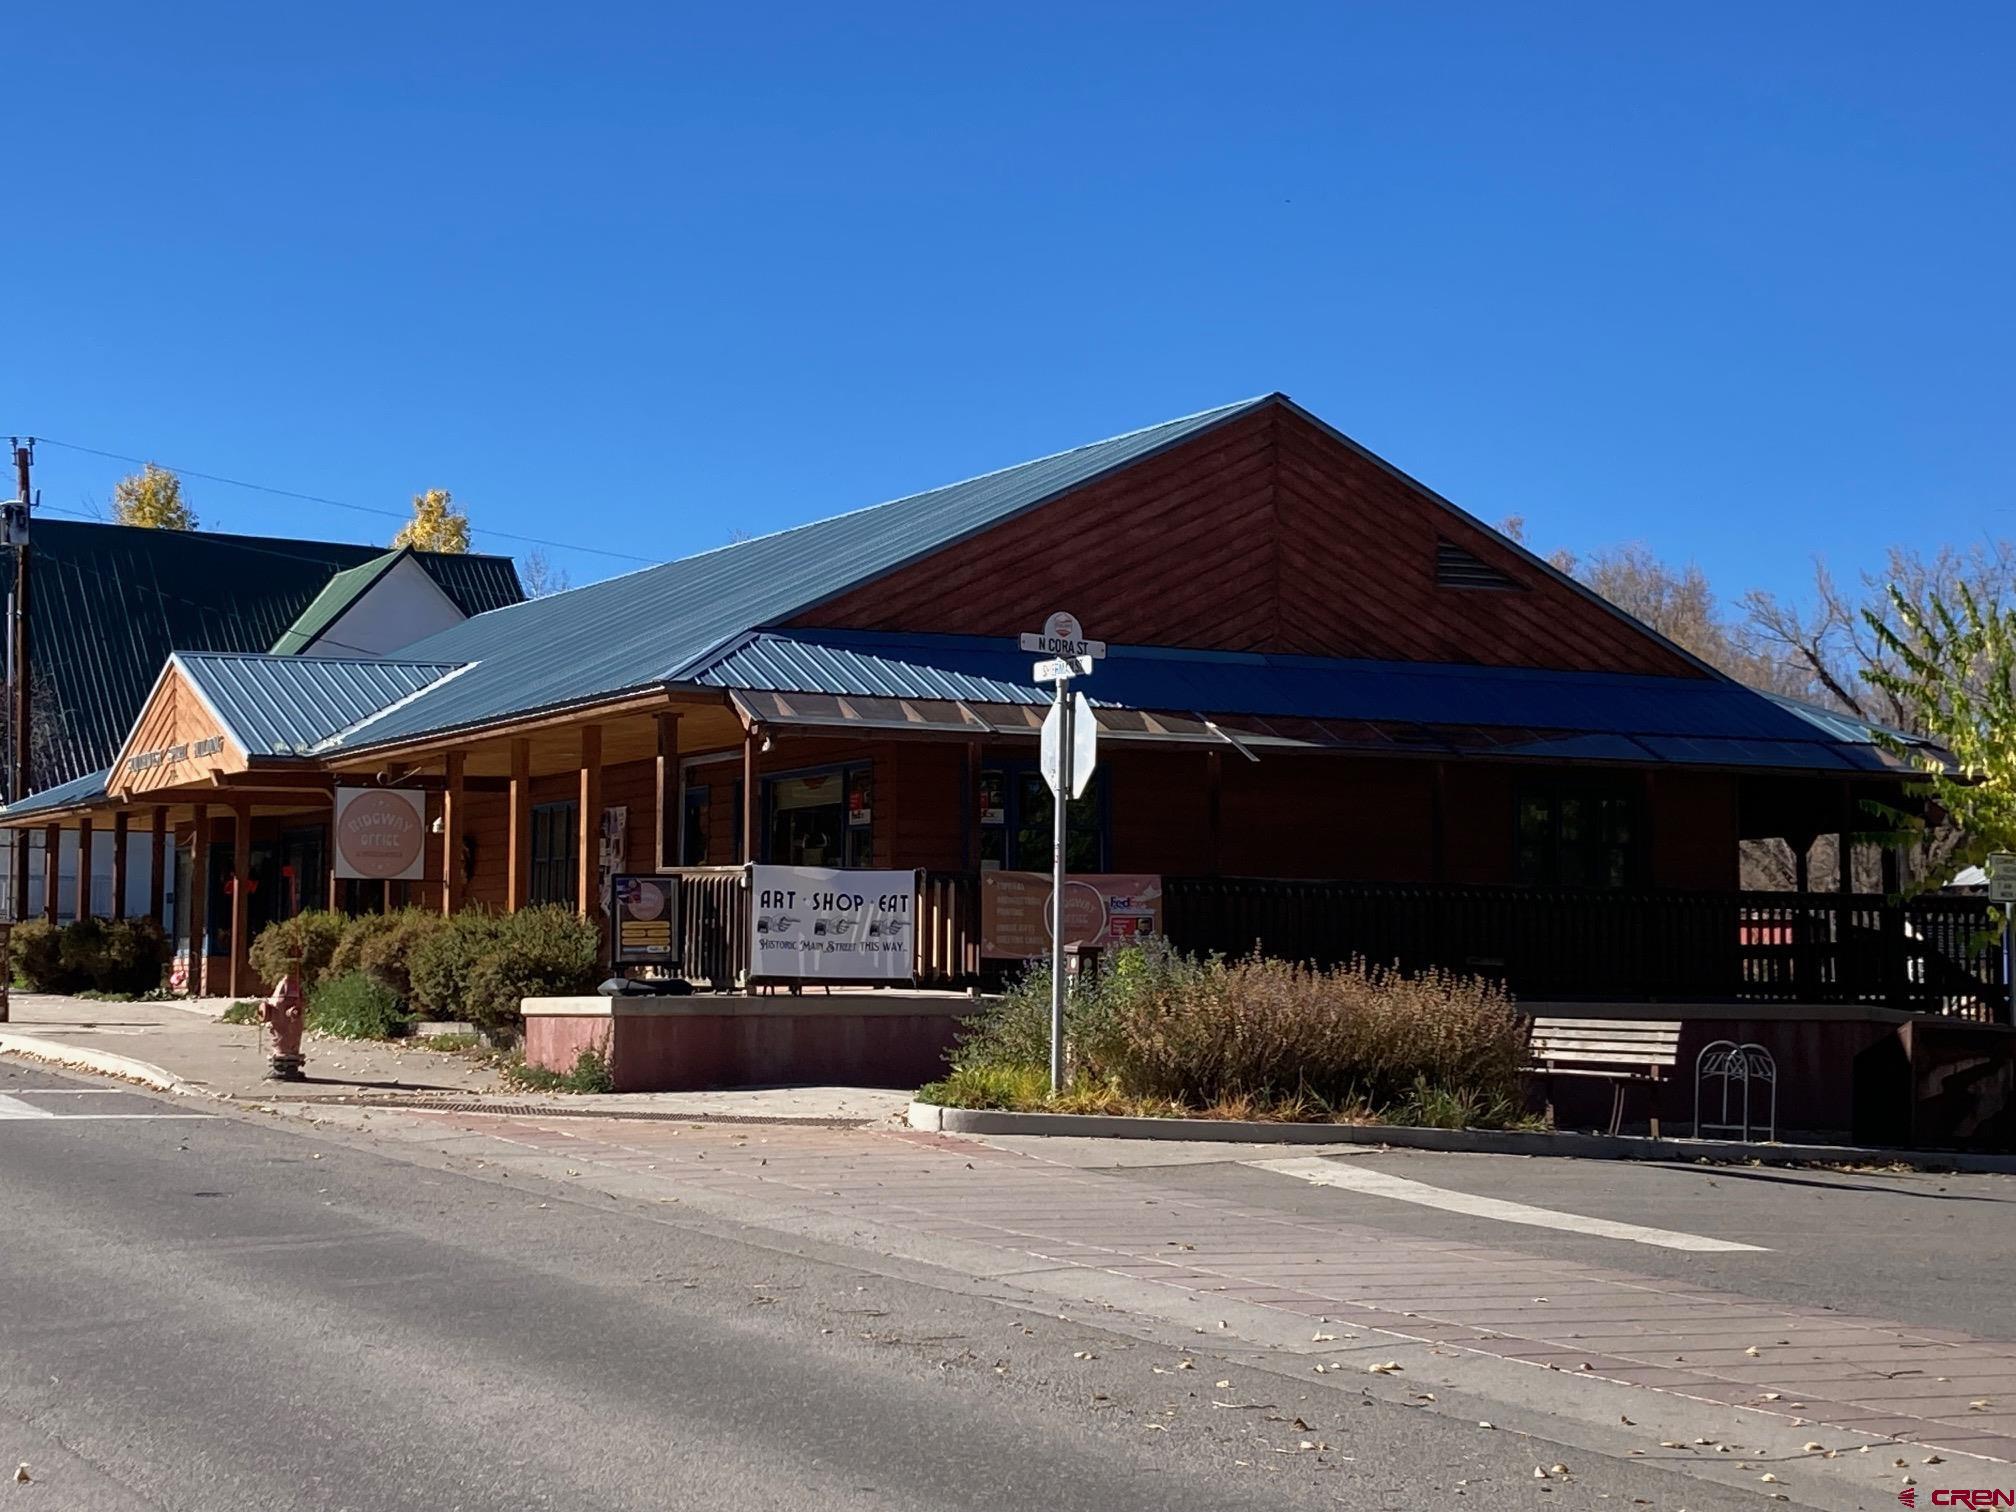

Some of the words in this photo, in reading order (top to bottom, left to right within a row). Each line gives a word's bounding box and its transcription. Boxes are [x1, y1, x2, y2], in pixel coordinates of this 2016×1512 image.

[1039, 637, 1046, 650] N
[1048, 638, 1075, 654] CORA
[1076, 642, 1089, 655] ST
[347, 812, 414, 833] RIDGWAY
[360, 832, 400, 848] OFFICE
[760, 890, 796, 909] ART
[812, 892, 864, 912] SHOP
[878, 894, 909, 913] EAT
[759, 938, 797, 951] HISTORIC
[799, 940, 824, 952] MAIN
[823, 941, 857, 954] STREET
[860, 941, 880, 952] THIS
